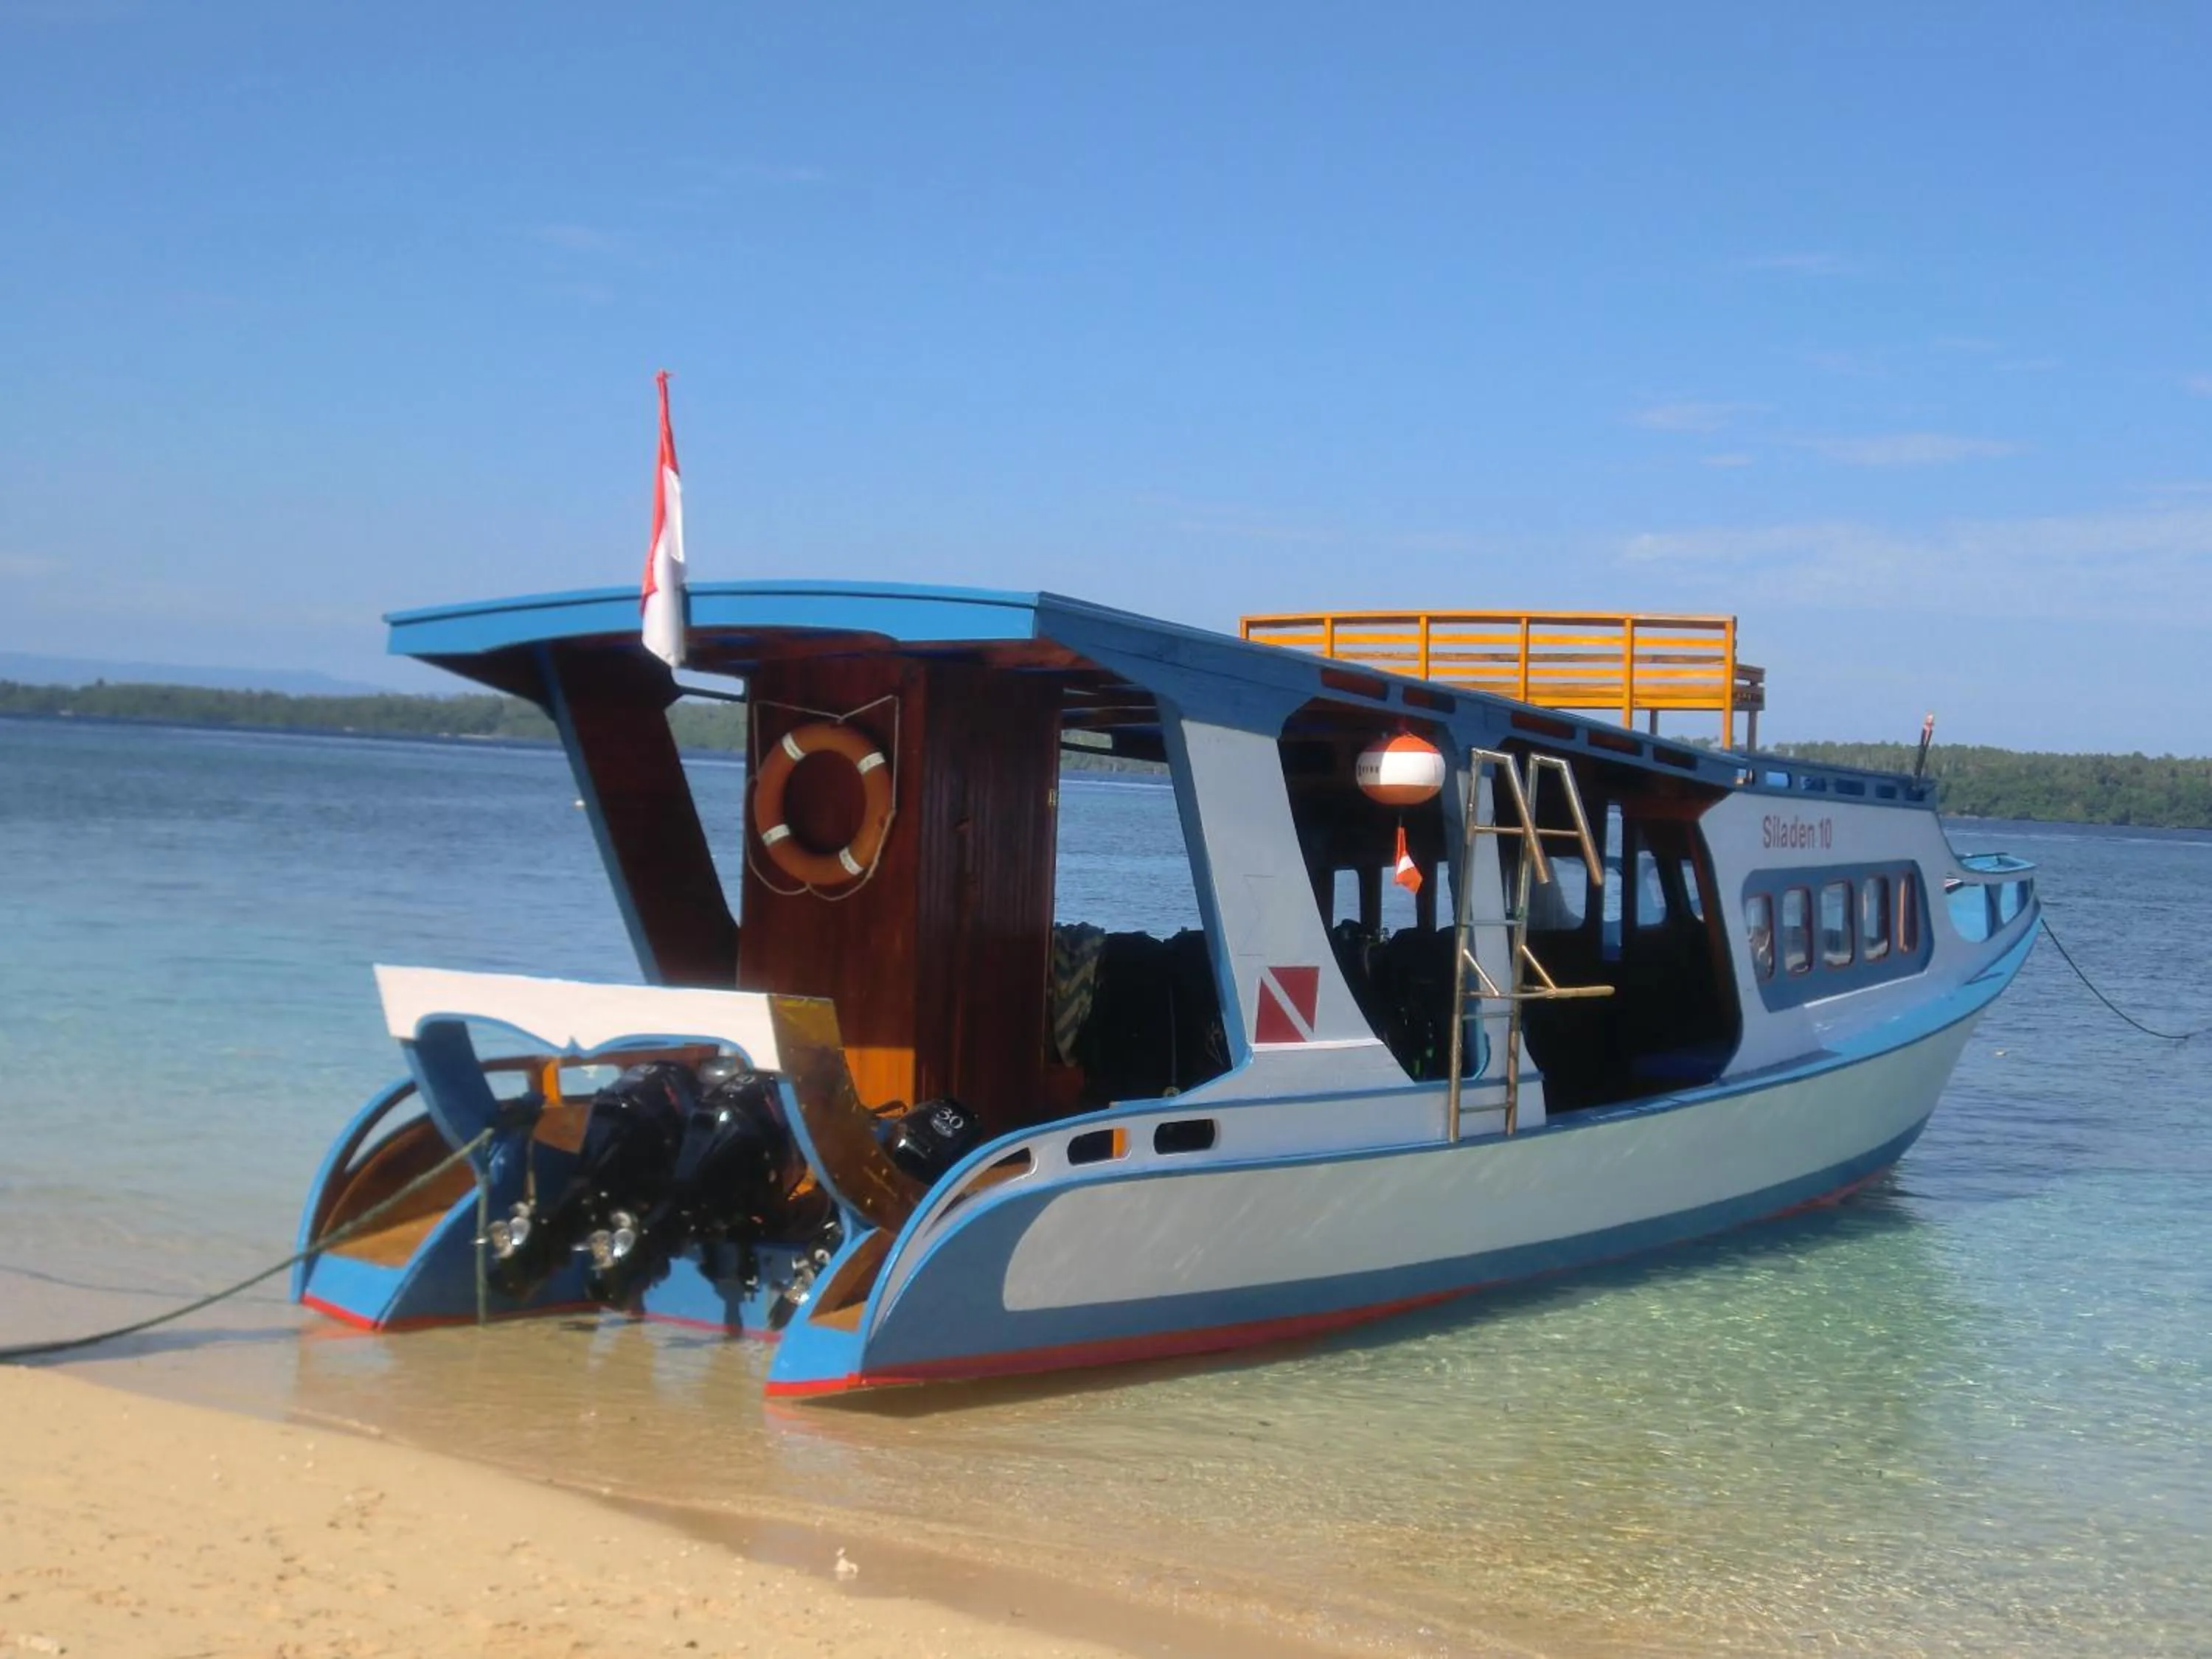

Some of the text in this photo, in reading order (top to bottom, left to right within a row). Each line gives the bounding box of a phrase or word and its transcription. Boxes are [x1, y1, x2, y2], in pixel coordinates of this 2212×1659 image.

[1763, 814, 1832, 850] Siladen 10
[936, 1107, 964, 1129] 30
